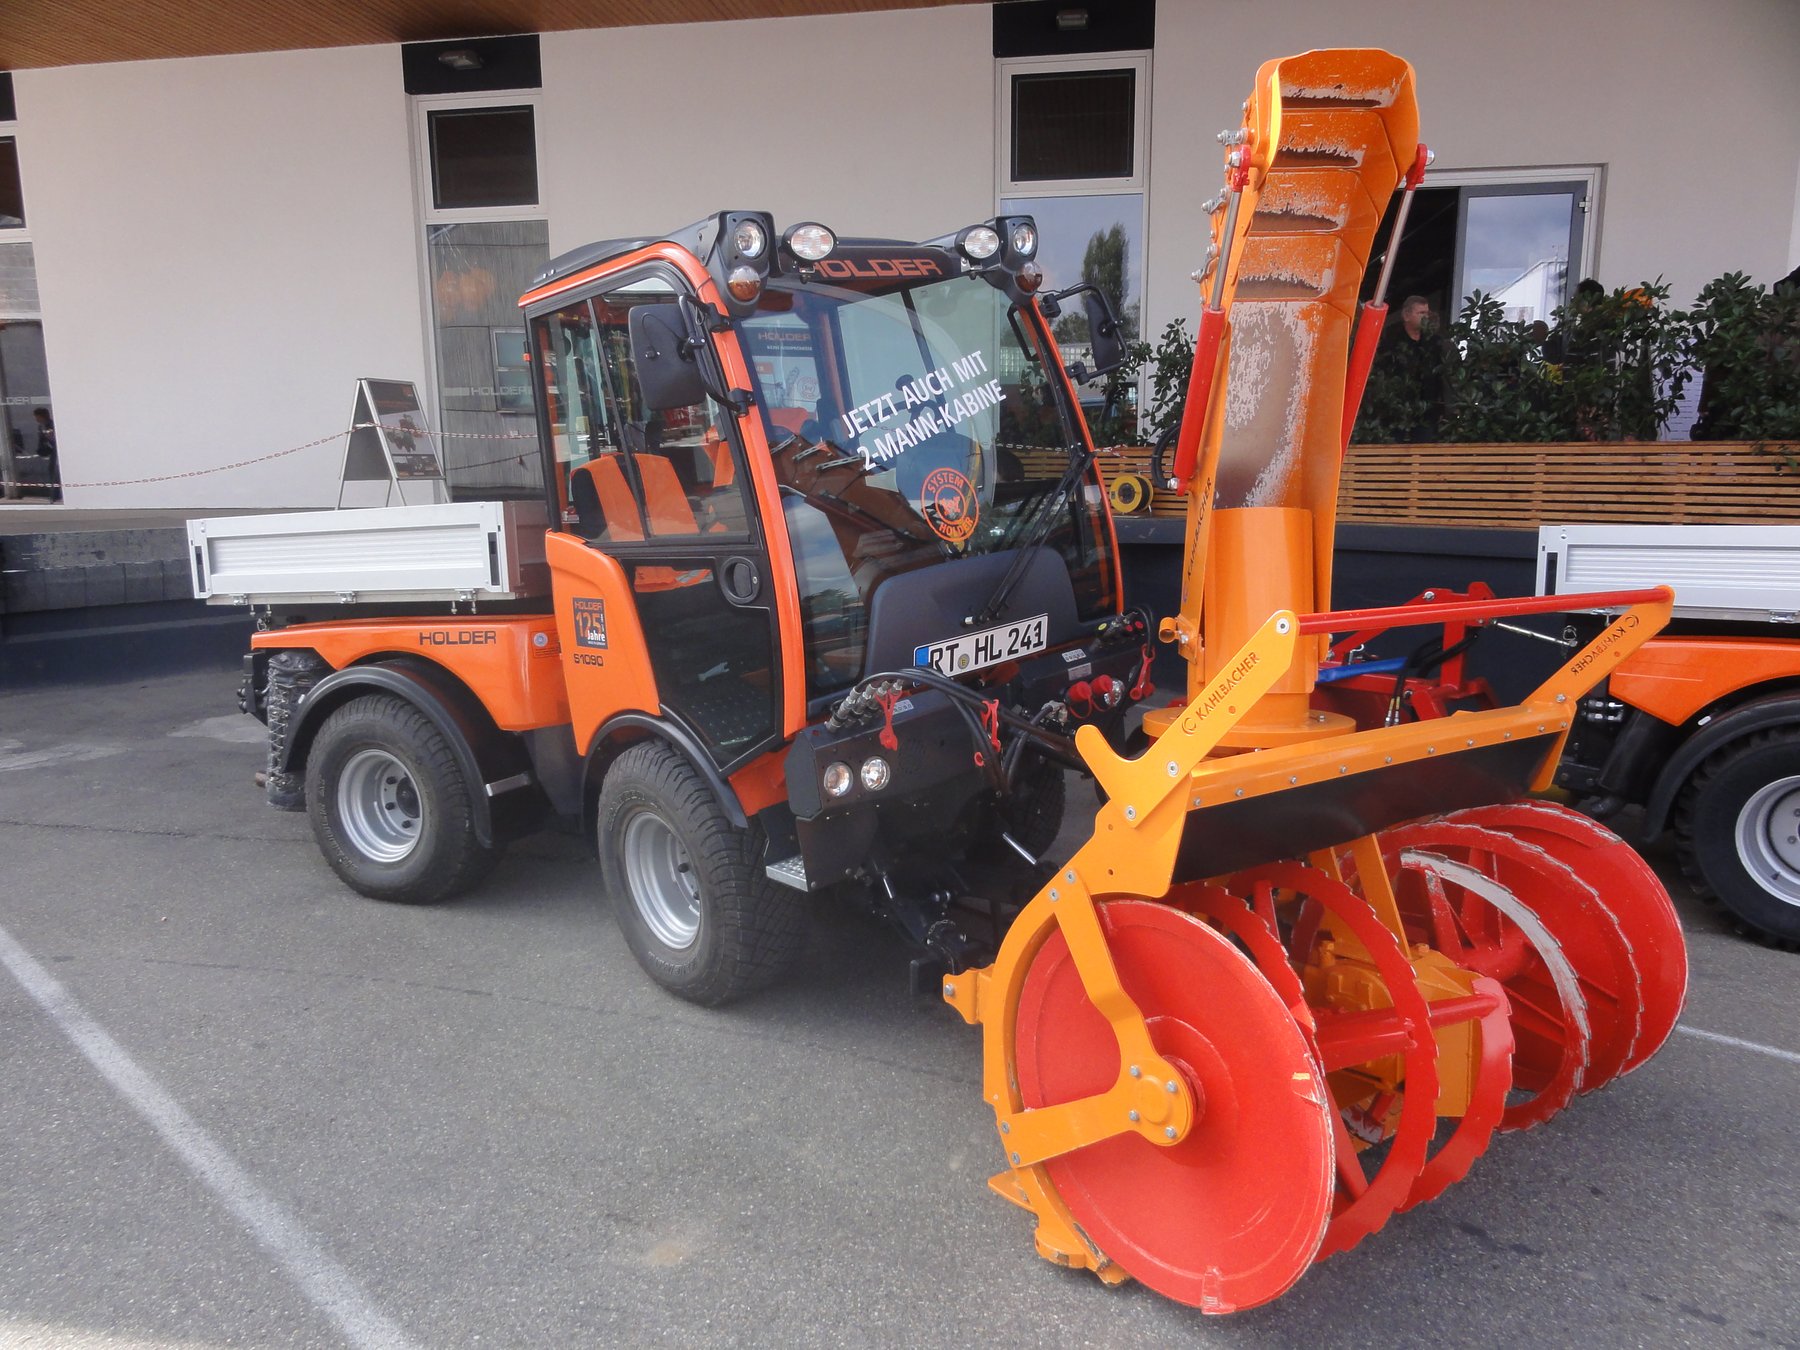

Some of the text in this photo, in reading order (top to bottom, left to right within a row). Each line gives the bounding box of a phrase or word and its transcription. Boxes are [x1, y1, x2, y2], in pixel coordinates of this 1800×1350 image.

[471, 386, 528, 396] HOLDER
[842, 350, 988, 439] JETZT AUCH MIT
[857, 378, 1007, 471] 2-MANN-KABINE
[928, 472, 965, 493] SYSTEM
[938, 516, 974, 537] HOLDER
[574, 601, 602, 611] HOLDER
[576, 611, 602, 638] 125
[419, 630, 497, 646] HOLDER
[587, 629, 606, 642] Jahre
[930, 643, 960, 674] RT
[975, 634, 1002, 665] HL
[1007, 620, 1044, 656] 241
[573, 653, 604, 667] S1090
[1195, 651, 1261, 721] KAHLBACHER
